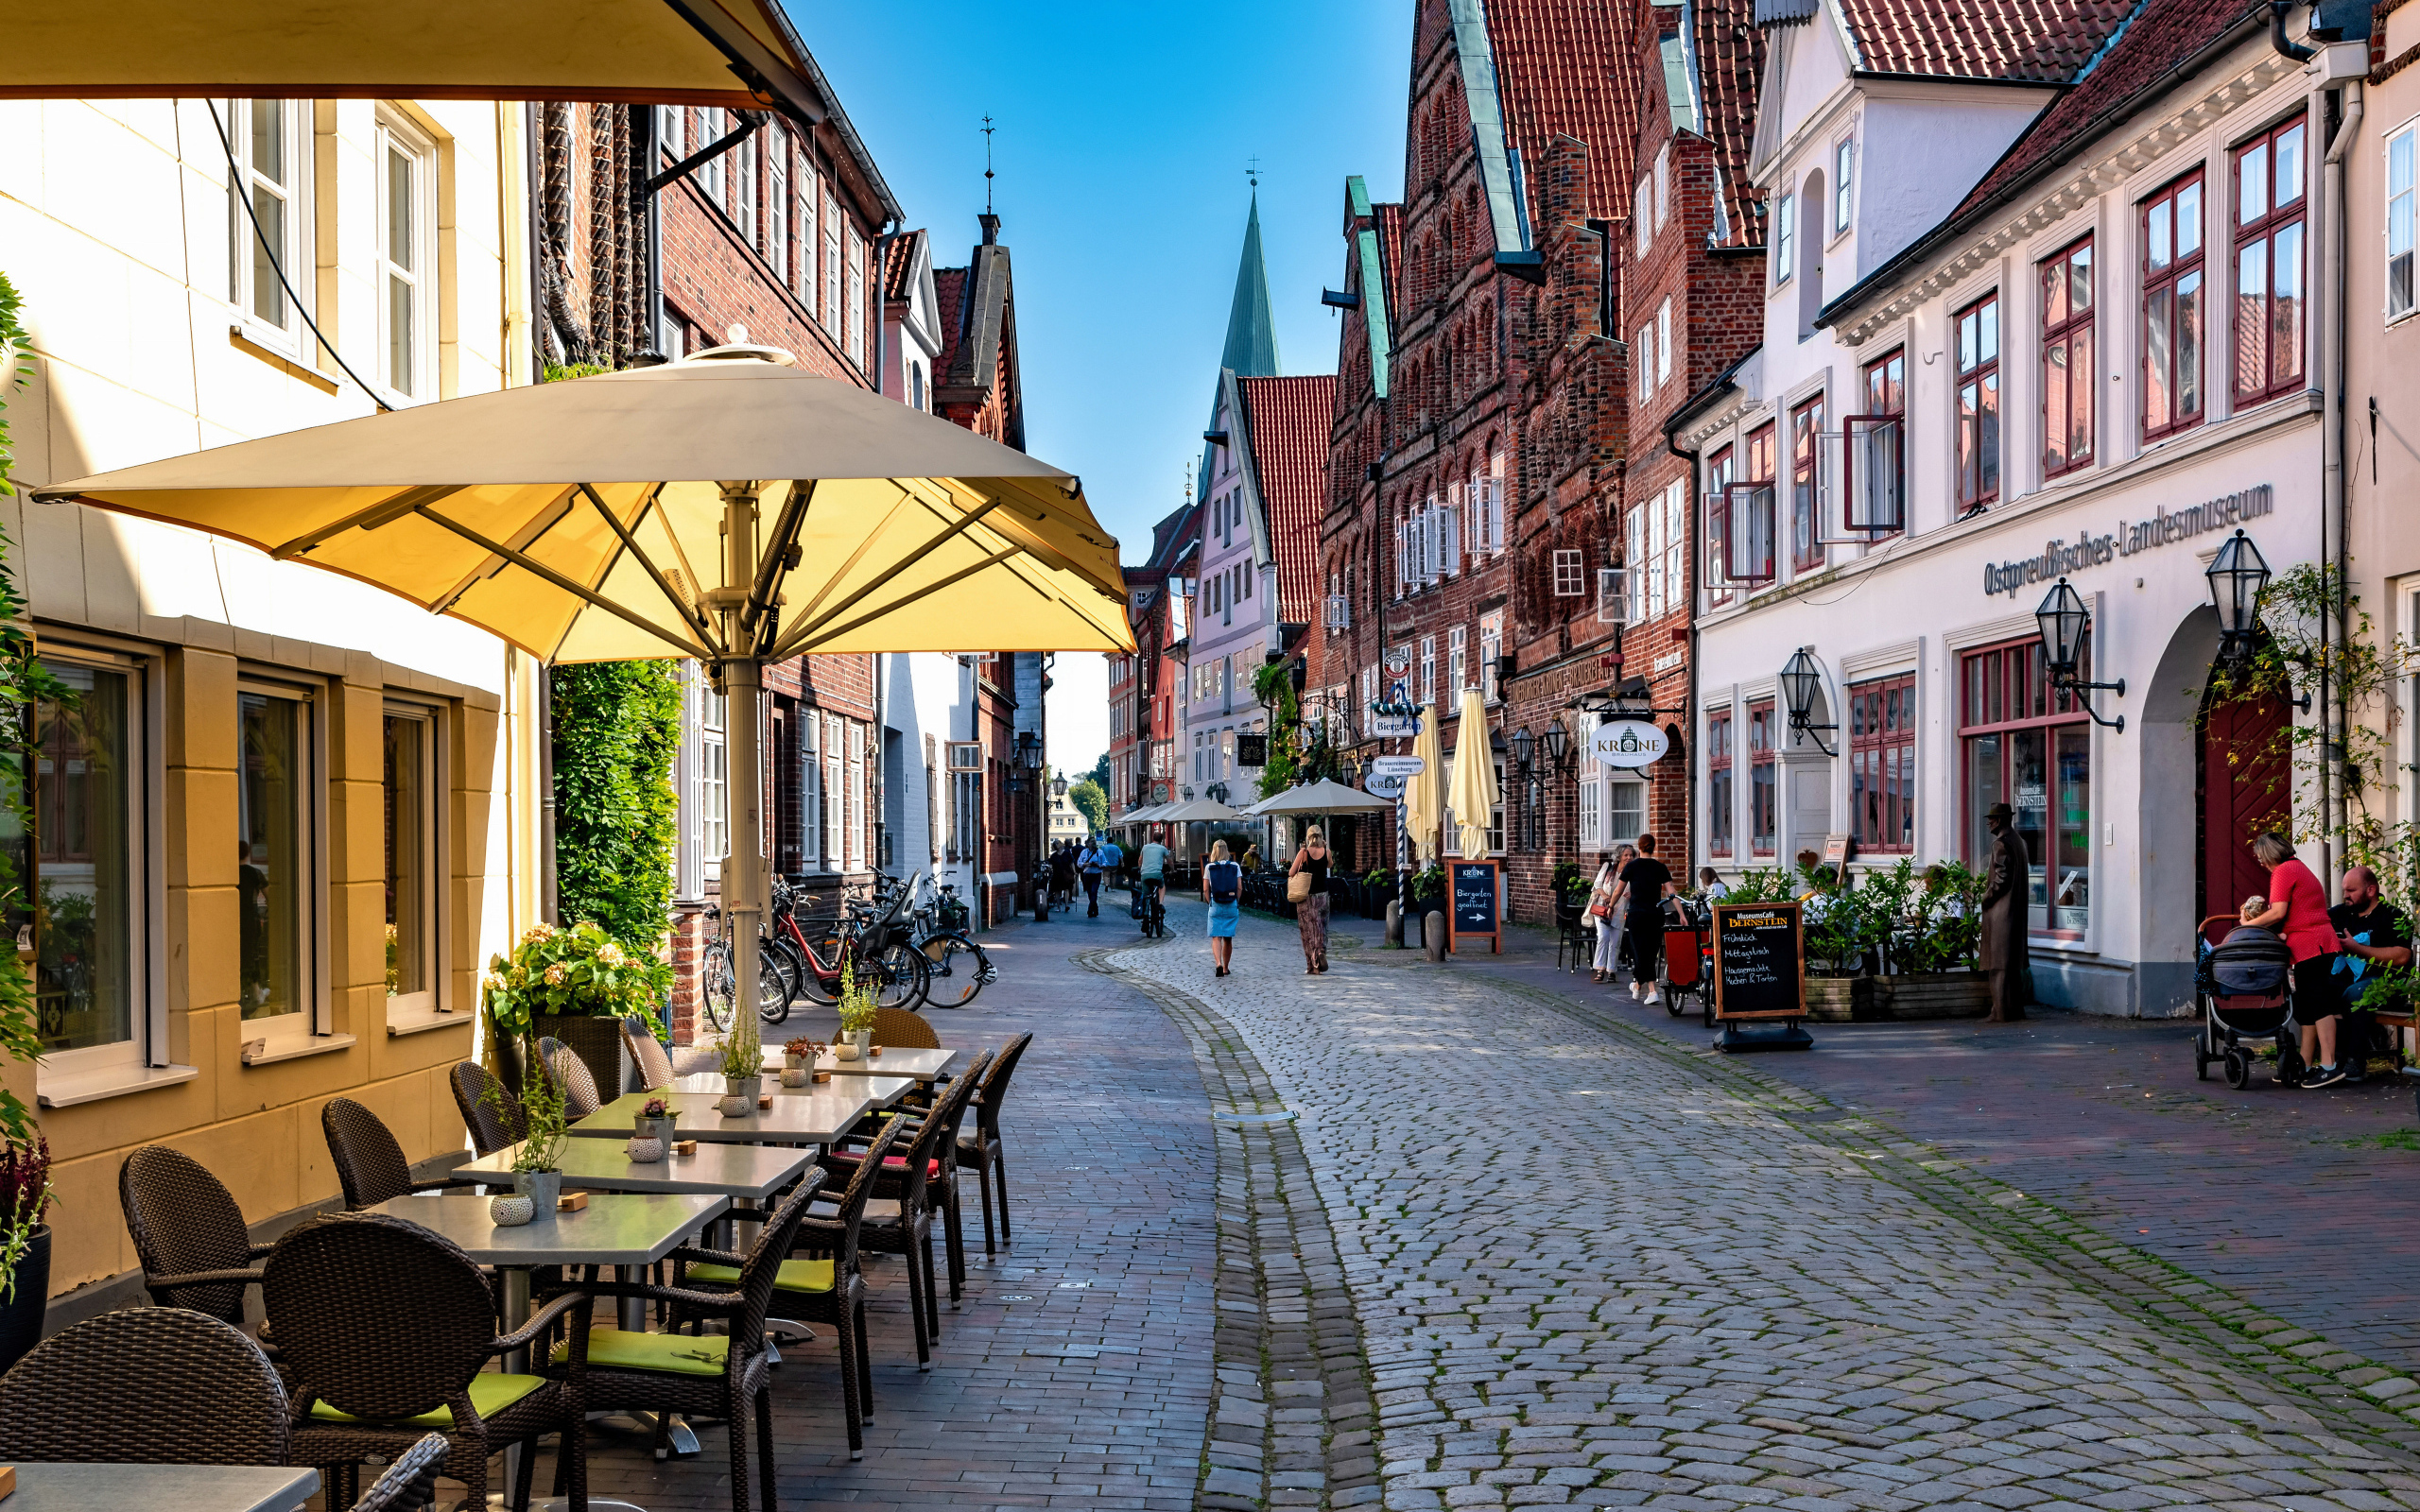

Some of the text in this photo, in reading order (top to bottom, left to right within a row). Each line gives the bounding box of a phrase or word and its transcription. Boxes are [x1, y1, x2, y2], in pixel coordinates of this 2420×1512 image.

[1984, 483, 2273, 599] Ostpreußisches Landesmuseum
[1457, 887, 1492, 899] Biergarten
[1737, 911, 1774, 919] MuseumsCafé
[1728, 917, 1788, 928] BERNSTEIN
[1721, 934, 1757, 942] Frühstück
[1724, 946, 1770, 959] Mittagstisch
[1749, 972, 1755, 983] &
